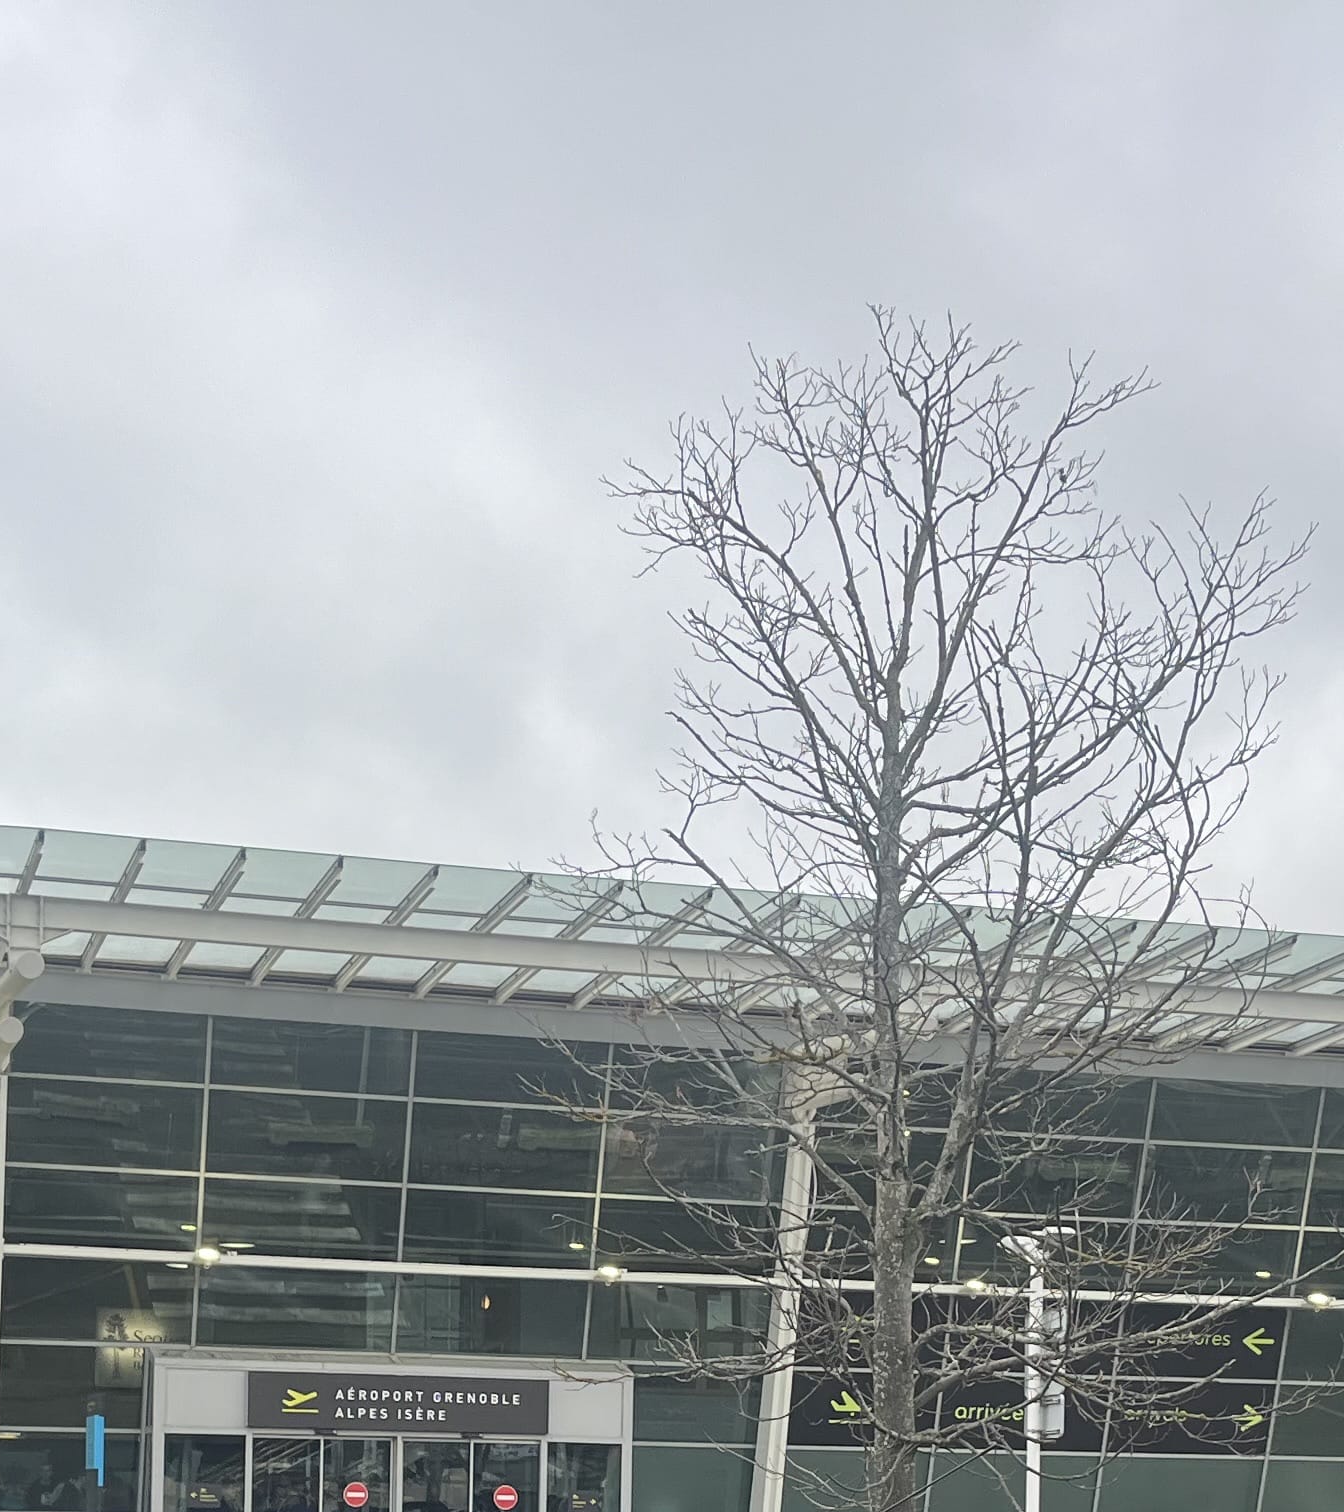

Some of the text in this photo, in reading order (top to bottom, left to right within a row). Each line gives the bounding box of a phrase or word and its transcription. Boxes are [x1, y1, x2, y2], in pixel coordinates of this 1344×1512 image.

[335, 1386, 521, 1406] AÉROPORT GRENOBLE
[334, 1407, 447, 1421] ALPES ISÈRE
